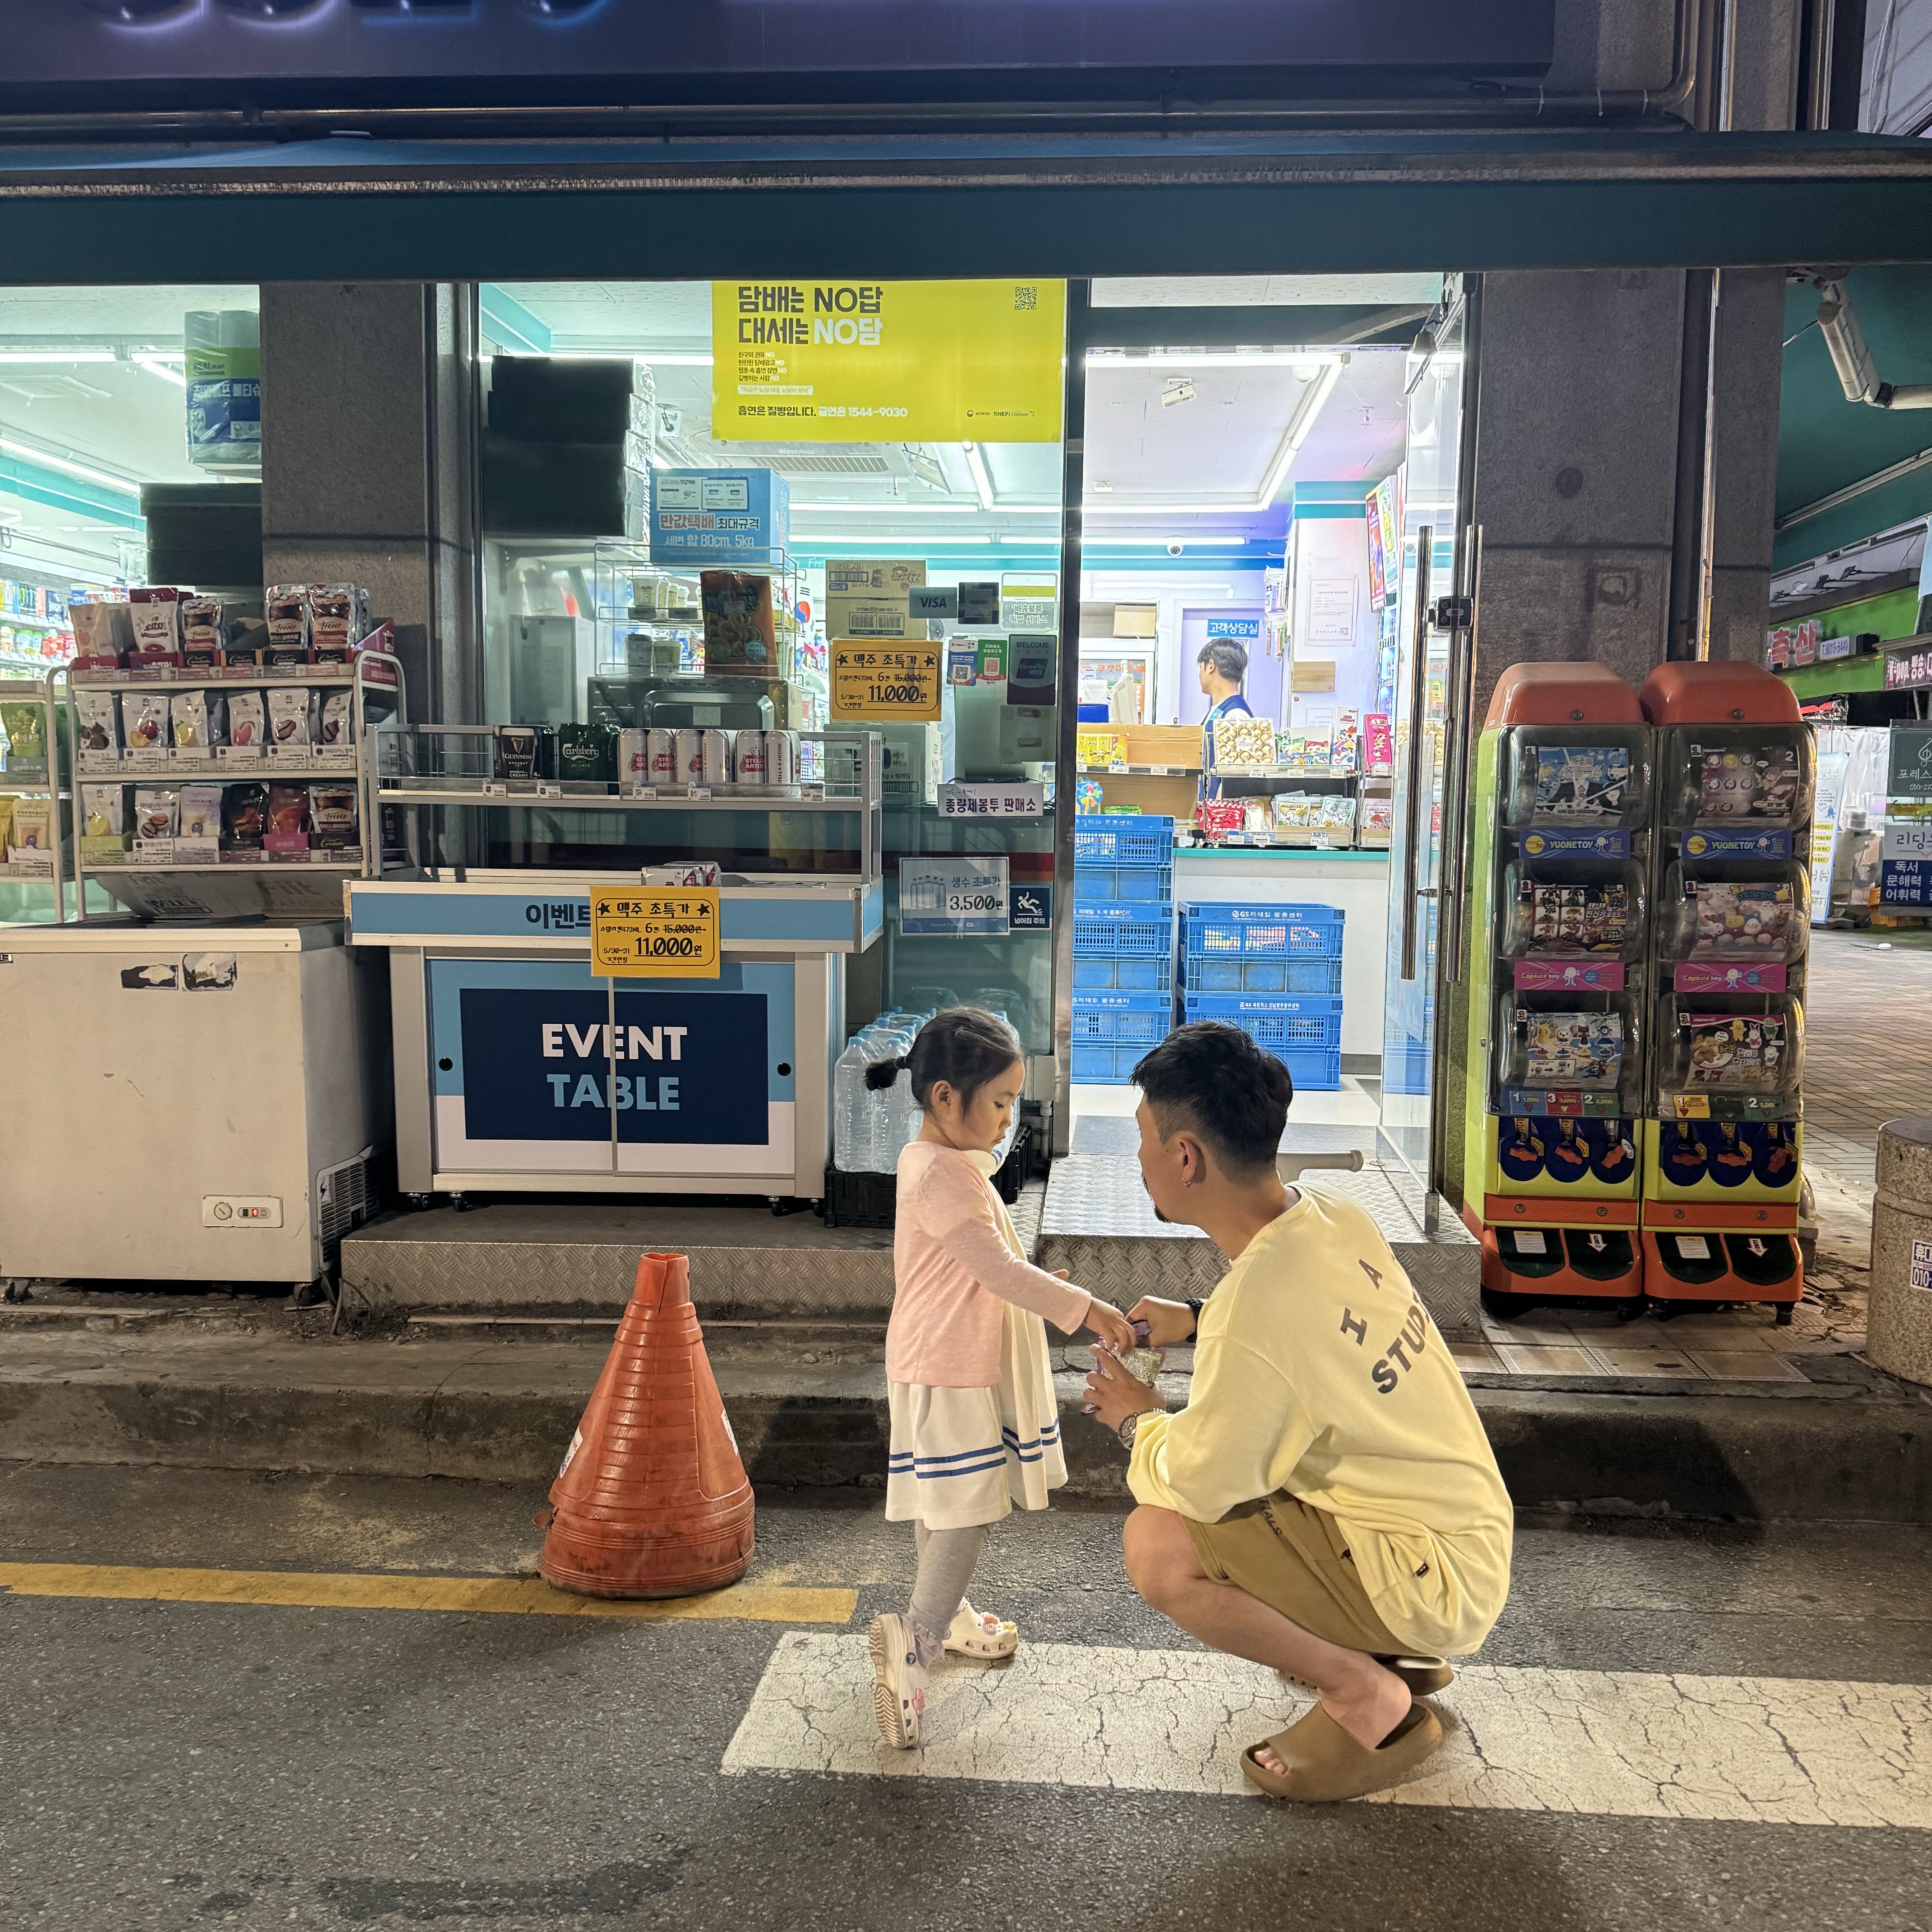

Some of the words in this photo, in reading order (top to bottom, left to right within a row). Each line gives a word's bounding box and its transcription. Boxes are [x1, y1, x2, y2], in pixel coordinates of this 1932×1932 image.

[739, 286, 804, 313] 담배는
[814, 287, 883, 313] NO답
[739, 317, 808, 345] 대세는
[814, 317, 883, 345] NO담
[738, 406, 765, 416] 흡연은
[768, 406, 816, 416] 질병입니다.
[819, 406, 846, 417] 금연은
[848, 407, 908, 417] 1544-9030
[660, 514, 715, 530] 반값택배
[717, 517, 759, 529] 최대규격
[665, 535, 684, 546] 세변
[687, 534, 699, 547] 합
[736, 534, 754, 547] 5kg
[920, 598, 946, 608] VISA
[1025, 614, 1048, 623] 서비스
[1209, 622, 1257, 635] 고객상담실
[854, 653, 876, 667] 맥주
[883, 654, 917, 668] 초특가
[869, 685, 927, 701] 11,000원
[563, 744, 599, 758] Carlsberg
[1564, 766, 1603, 777] 랜덤박스
[946, 798, 999, 813] 종량제봉투
[1004, 798, 1036, 812] 판매소
[1550, 841, 1594, 849] YUONETOY
[1711, 842, 1756, 850] YUONETOY
[1895, 861, 1918, 874] 독서
[952, 877, 970, 888] 생수
[973, 877, 1001, 888] 초특가
[1886, 875, 1922, 888] 문해력
[1886, 888, 1921, 902] 어휘력
[950, 895, 1003, 911] 3,500원
[617, 902, 643, 917] 맥주
[650, 902, 690, 918] 초특가
[1586, 909, 1606, 918] 변신카
[635, 937, 702, 956] 11,000원
[1521, 972, 1547, 980] Capsule
[1683, 975, 1710, 983] Capsule
[542, 1023, 687, 1060] EVENT
[547, 1074, 680, 1110] TABLE
[1513, 1092, 1520, 1102] 1
[1547, 1094, 1556, 1103] 3
[1584, 1095, 1593, 1104] 2
[1677, 1096, 1685, 1107] 1
[1748, 1097, 1758, 1108] 2
[1340, 1307, 1367, 1346] I
[1359, 1259, 1382, 1290] A
